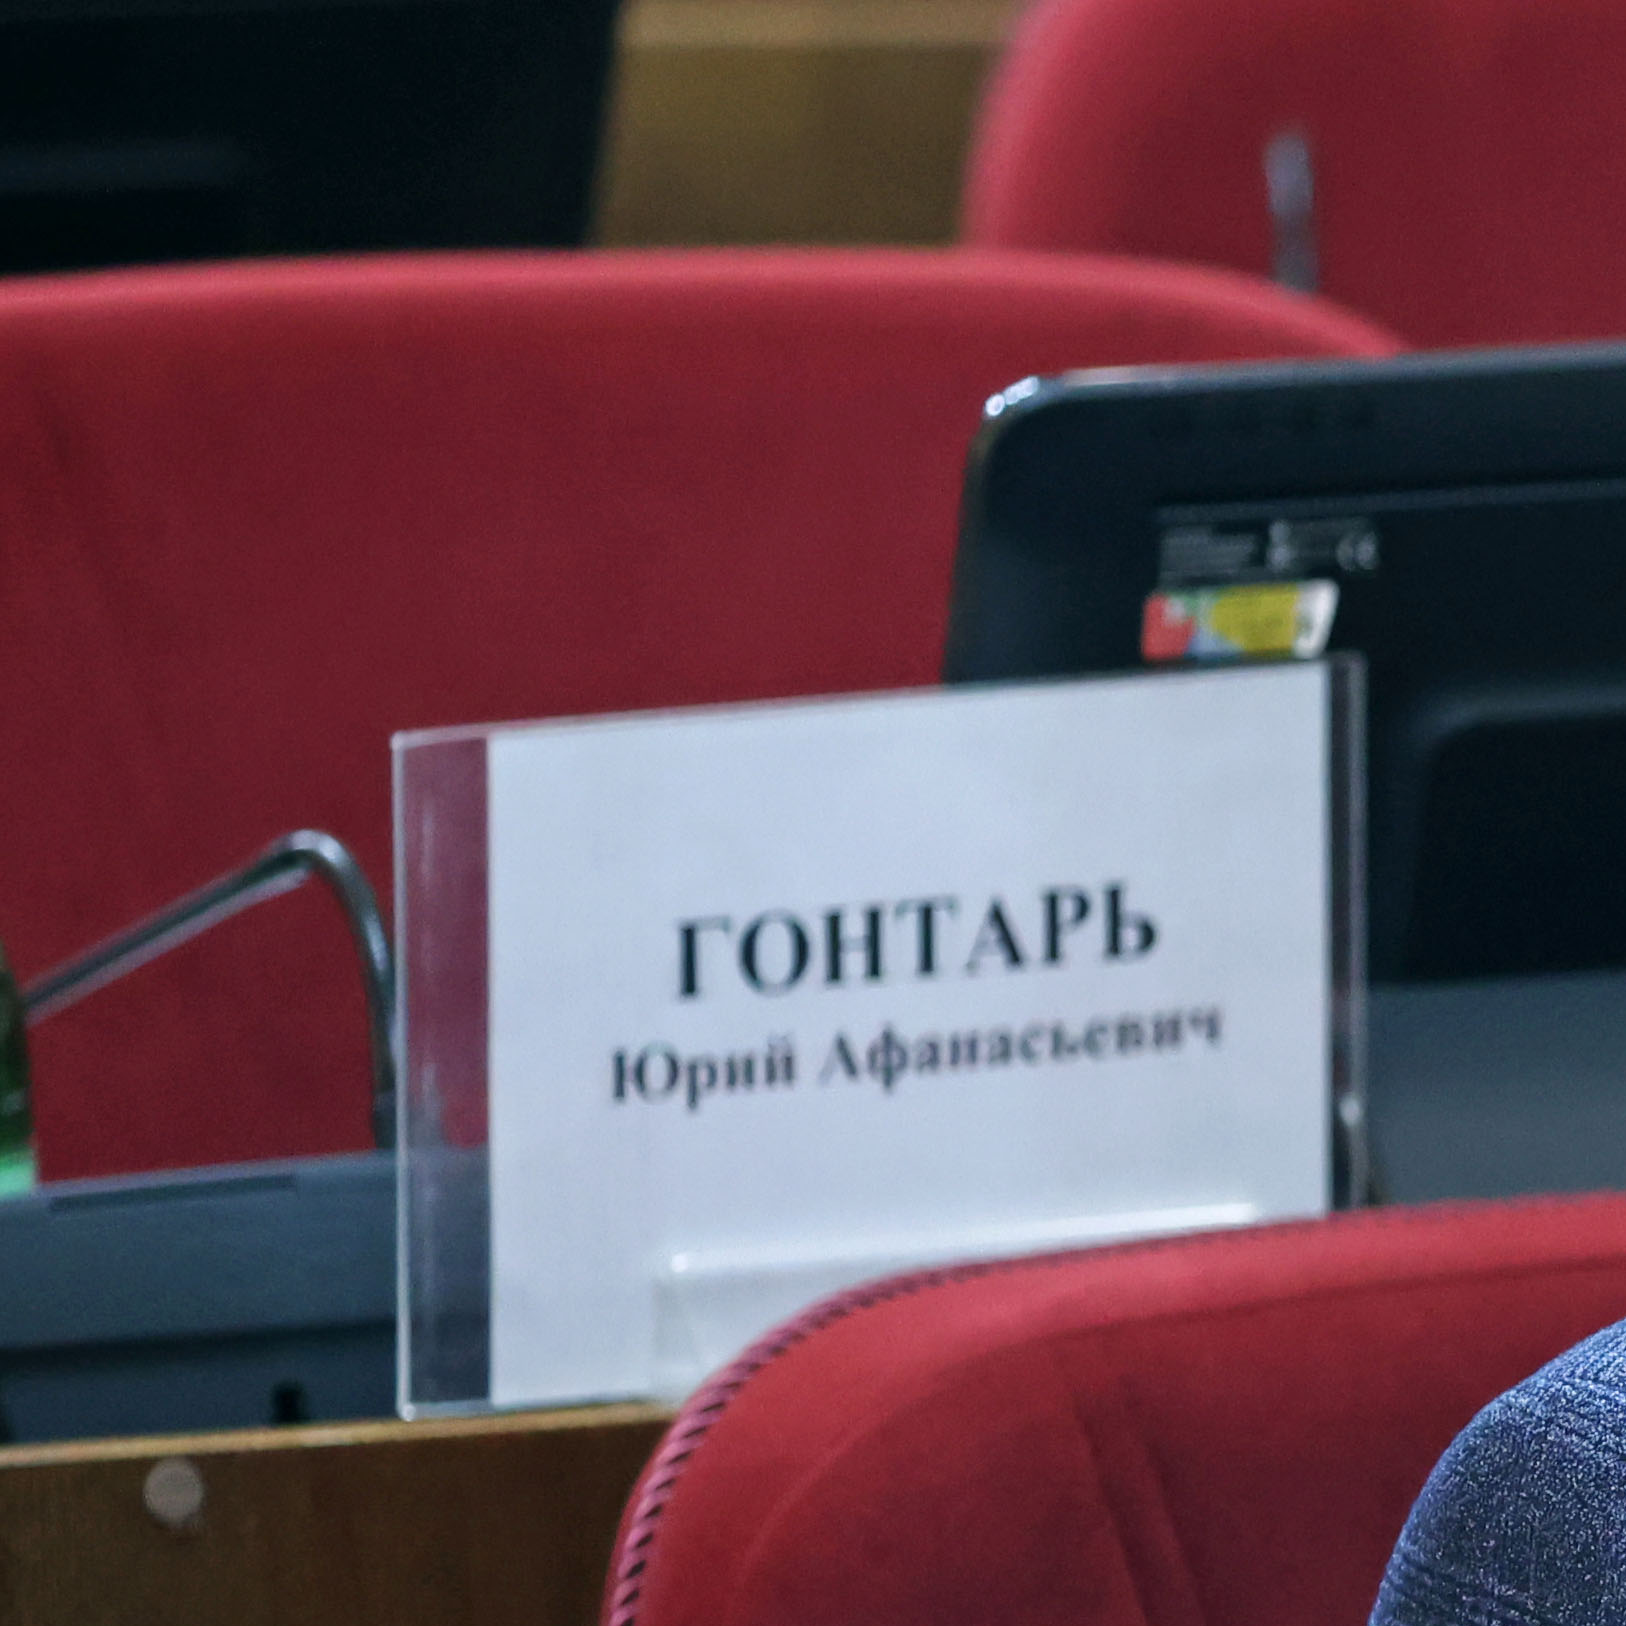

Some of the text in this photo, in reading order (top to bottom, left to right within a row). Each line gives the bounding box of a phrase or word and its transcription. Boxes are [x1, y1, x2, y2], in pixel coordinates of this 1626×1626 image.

[675, 878, 1162, 1003] ГОНТАРЬ
[610, 1006, 1224, 1115] Юрий Афанасьевич
